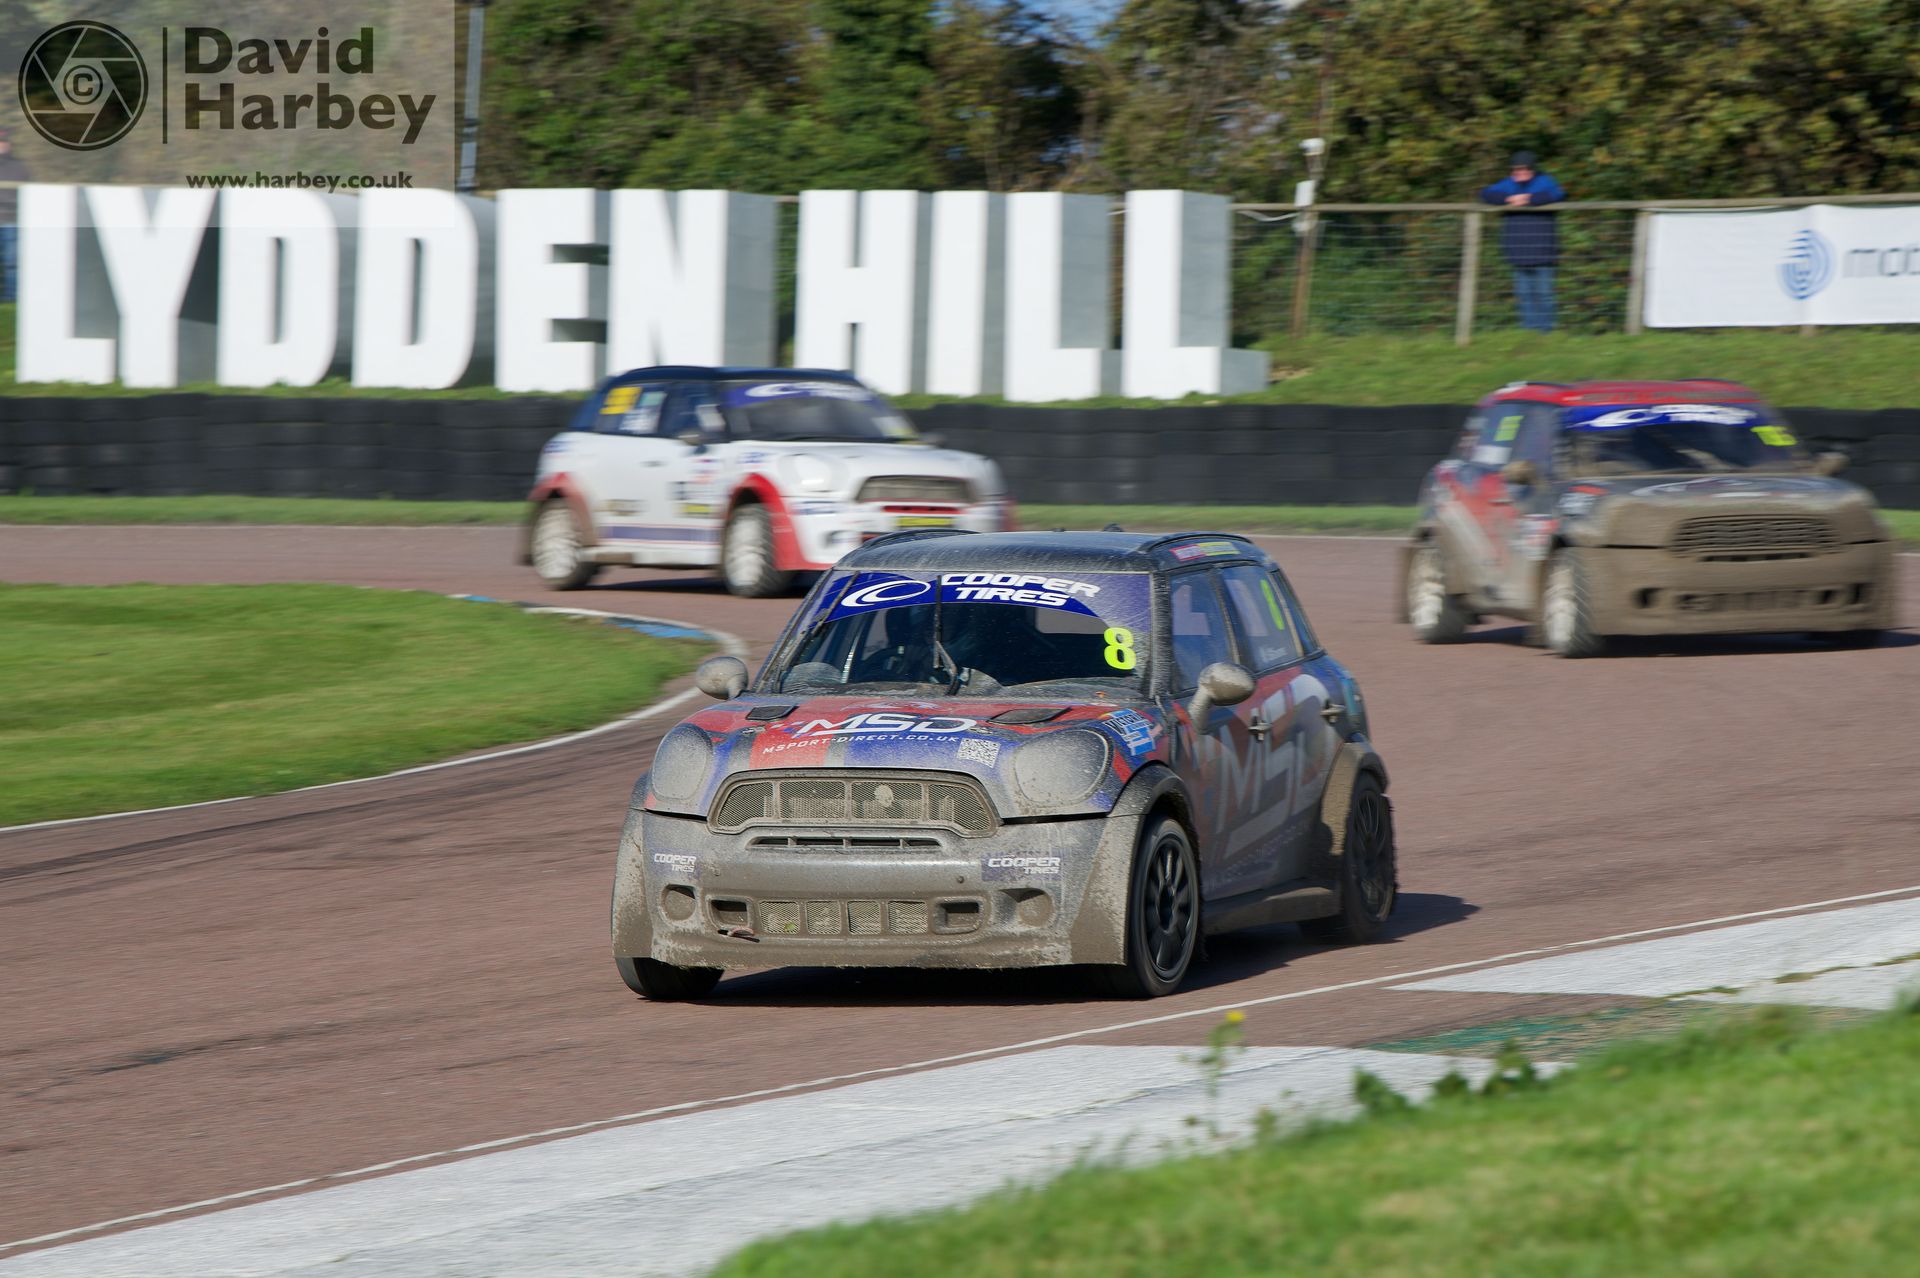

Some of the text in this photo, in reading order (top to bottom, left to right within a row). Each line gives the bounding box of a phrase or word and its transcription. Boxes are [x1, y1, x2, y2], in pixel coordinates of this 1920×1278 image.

[15, 186, 1224, 400] LYDDEN HILL
[941, 573, 1100, 598] COOPER
[955, 587, 1070, 606] TIRES
[1103, 627, 1137, 670] 8
[793, 713, 977, 738] MSD
[762, 734, 960, 755] MSPORT-DIRECT.CO.UK
[654, 853, 697, 865] COOPER
[988, 857, 1060, 867] COOPER
